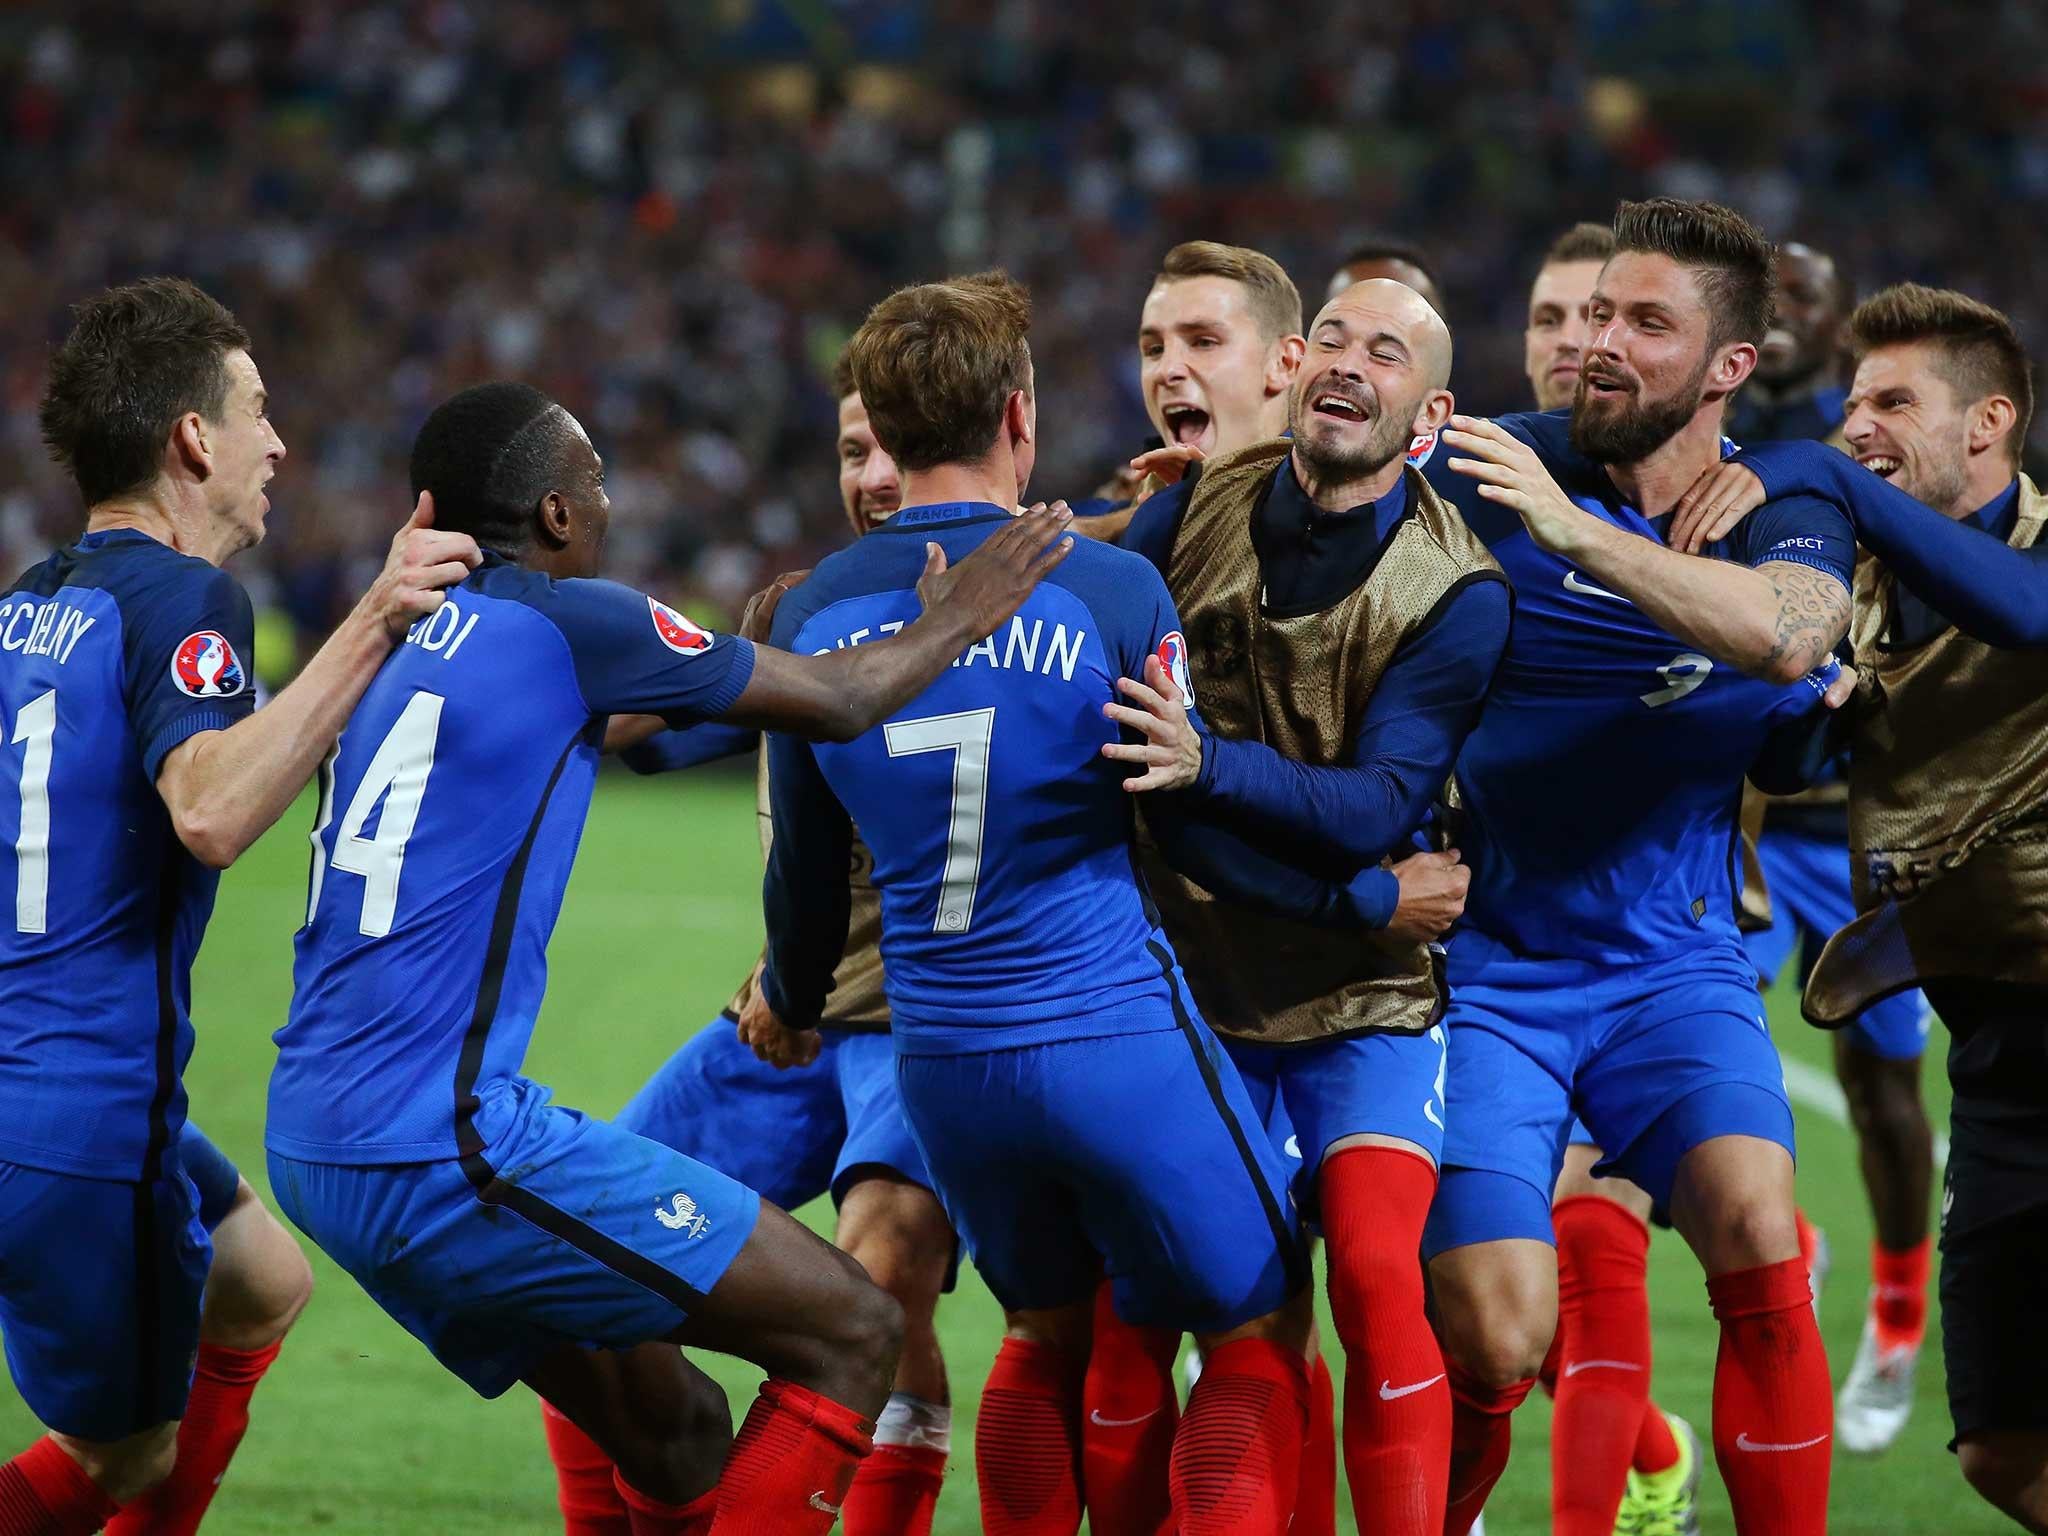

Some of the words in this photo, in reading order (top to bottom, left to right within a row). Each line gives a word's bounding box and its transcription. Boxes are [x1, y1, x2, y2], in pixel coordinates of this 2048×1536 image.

[1769, 537, 1824, 550] SPECT
[1639, 653, 1714, 709] 9
[0, 688, 56, 934] 1
[883, 707, 996, 934] 7
